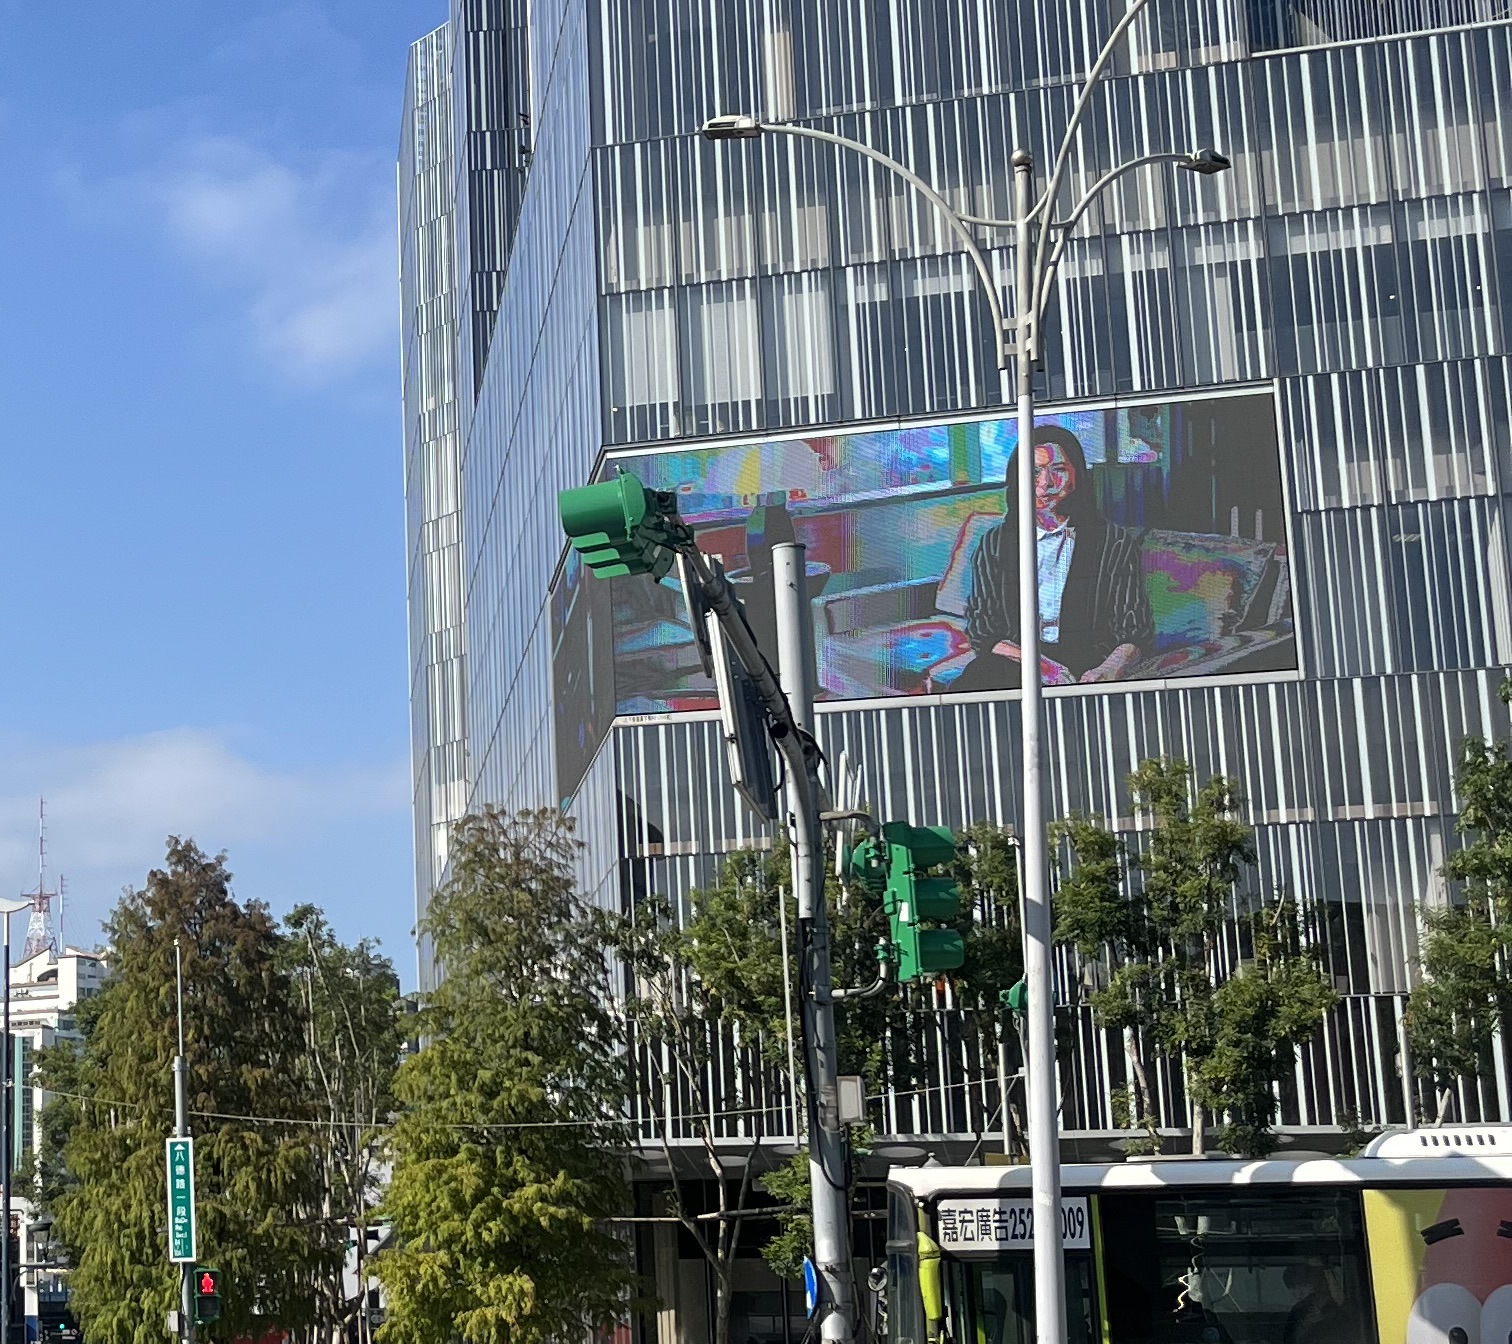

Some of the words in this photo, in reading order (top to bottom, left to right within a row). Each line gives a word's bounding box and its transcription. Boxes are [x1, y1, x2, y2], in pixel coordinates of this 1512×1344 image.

[174, 1151, 187, 1217] 八德路一段
[941, 1207, 1085, 1242] 嘉宏廣告252009
